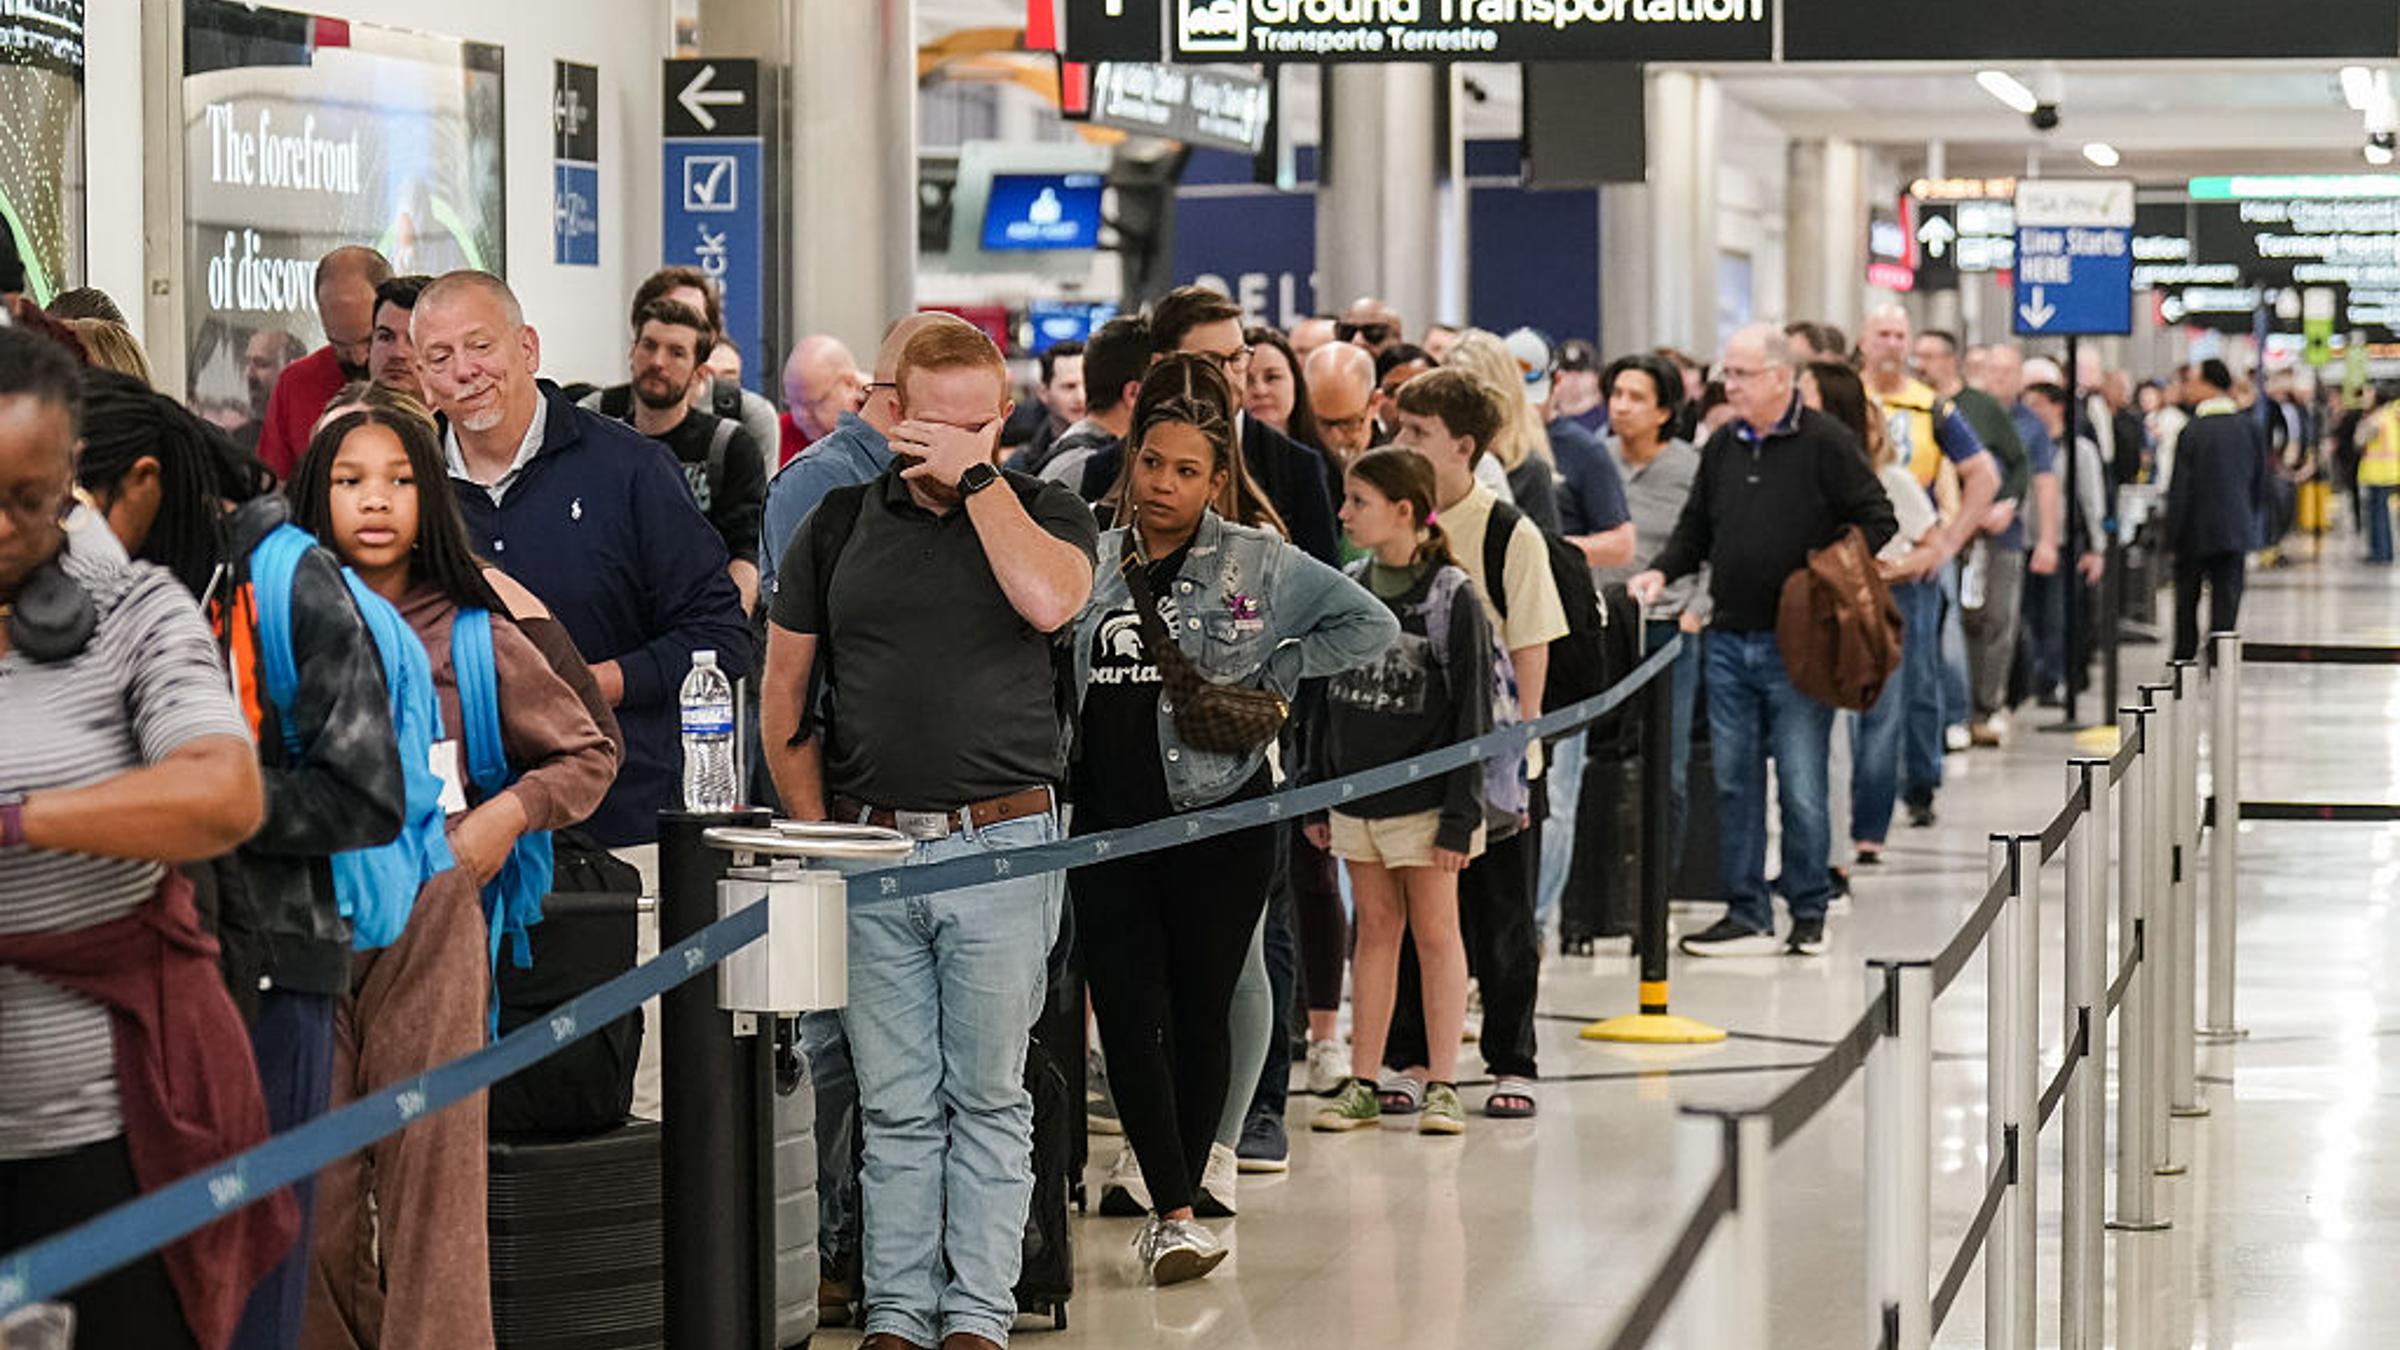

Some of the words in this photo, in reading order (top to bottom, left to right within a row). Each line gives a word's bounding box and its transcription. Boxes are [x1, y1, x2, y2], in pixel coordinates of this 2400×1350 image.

[1251, 0, 1421, 23] Ground
[1439, 0, 1763, 28] Transportation
[1252, 27, 1384, 53] Transporte
[1387, 27, 1499, 50] Terrestre
[206, 102, 254, 186] The
[259, 108, 360, 194] forefront
[2020, 229, 2064, 256] Line
[2066, 228, 2127, 257] Starts
[208, 231, 236, 310] of
[2020, 255, 2072, 284] HERE
[1194, 272, 1320, 330] EL
